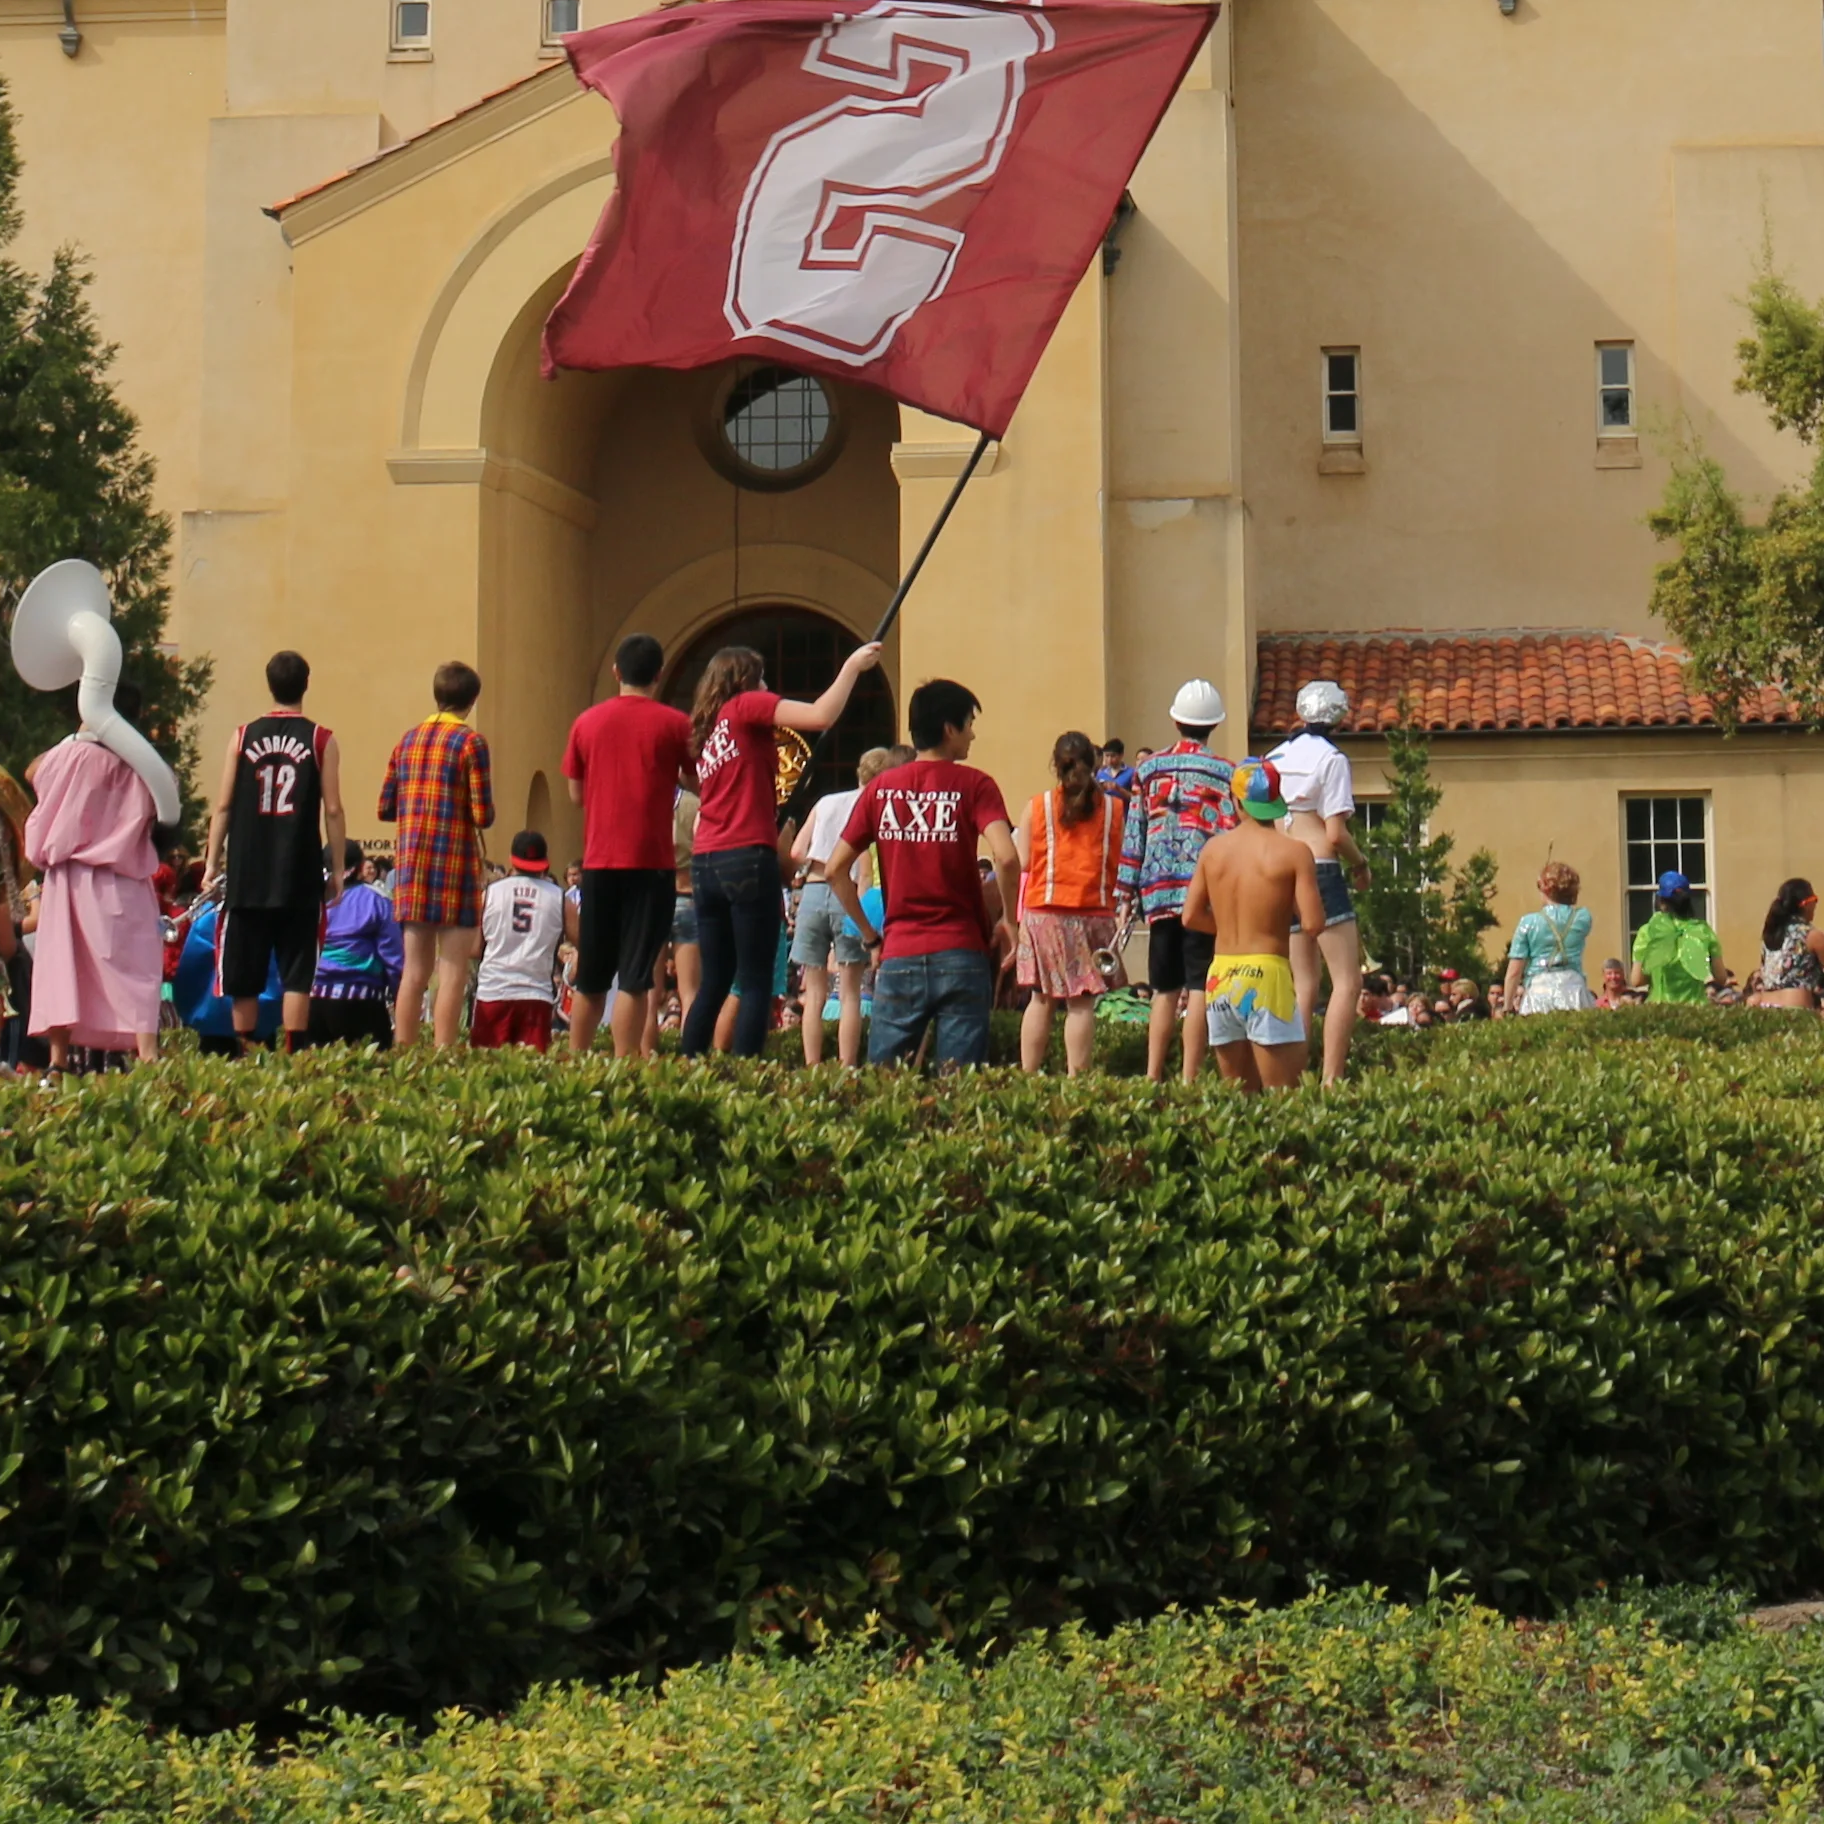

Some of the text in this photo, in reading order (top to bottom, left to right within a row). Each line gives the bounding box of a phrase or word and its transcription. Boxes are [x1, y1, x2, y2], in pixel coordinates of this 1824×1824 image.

[245, 735, 311, 764] ALDRIDGE
[257, 763, 297, 814] 12
[876, 788, 961, 802] STANFORD
[879, 799, 957, 833] AXE
[878, 830, 958, 843] COMMITTEE
[512, 899, 534, 933] 5
